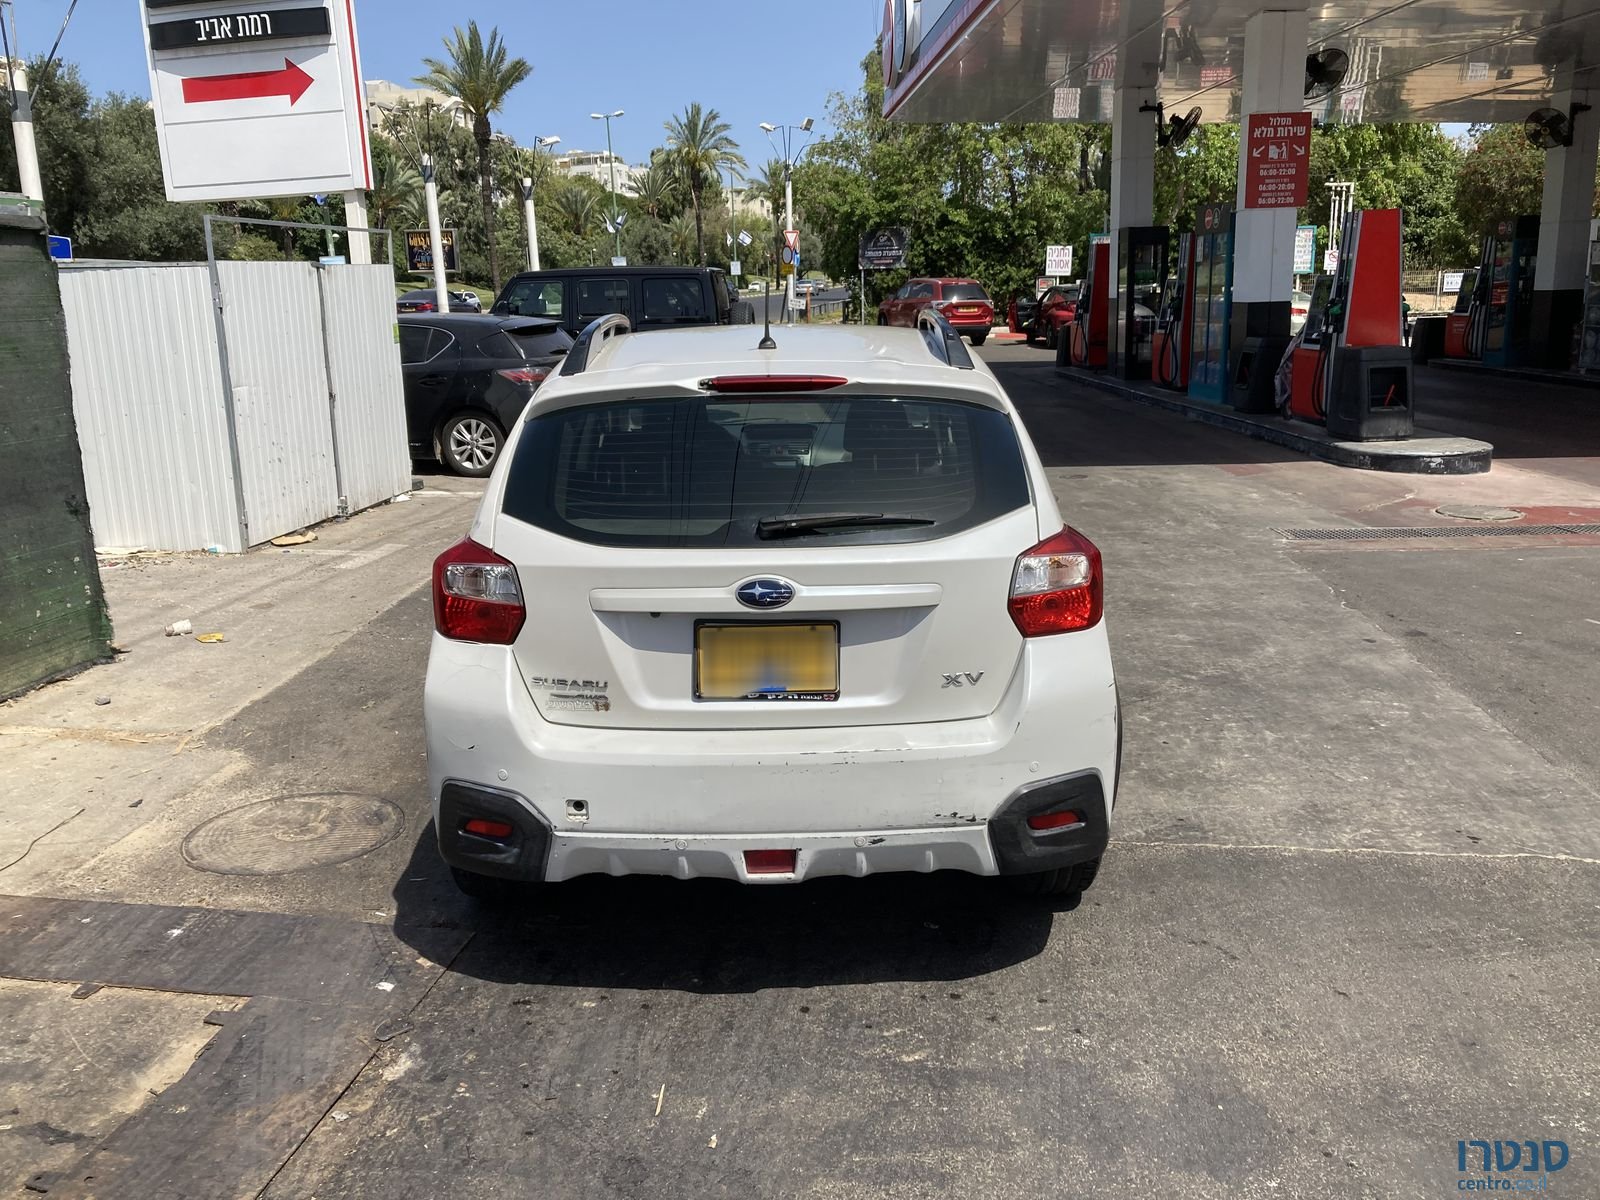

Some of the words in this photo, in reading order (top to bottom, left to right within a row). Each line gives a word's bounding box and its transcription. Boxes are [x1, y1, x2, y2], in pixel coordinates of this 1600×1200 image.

[195, 16, 233, 41] אביב
[236, 13, 272, 37] רמת
[1269, 117, 1292, 126] מסלול
[1253, 127, 1274, 138] מלא
[1276, 126, 1306, 137] שירות
[1048, 247, 1070, 258] החניה
[1047, 259, 1069, 269] אסורה
[531, 676, 609, 690] SUBARU
[941, 670, 985, 688] XV
